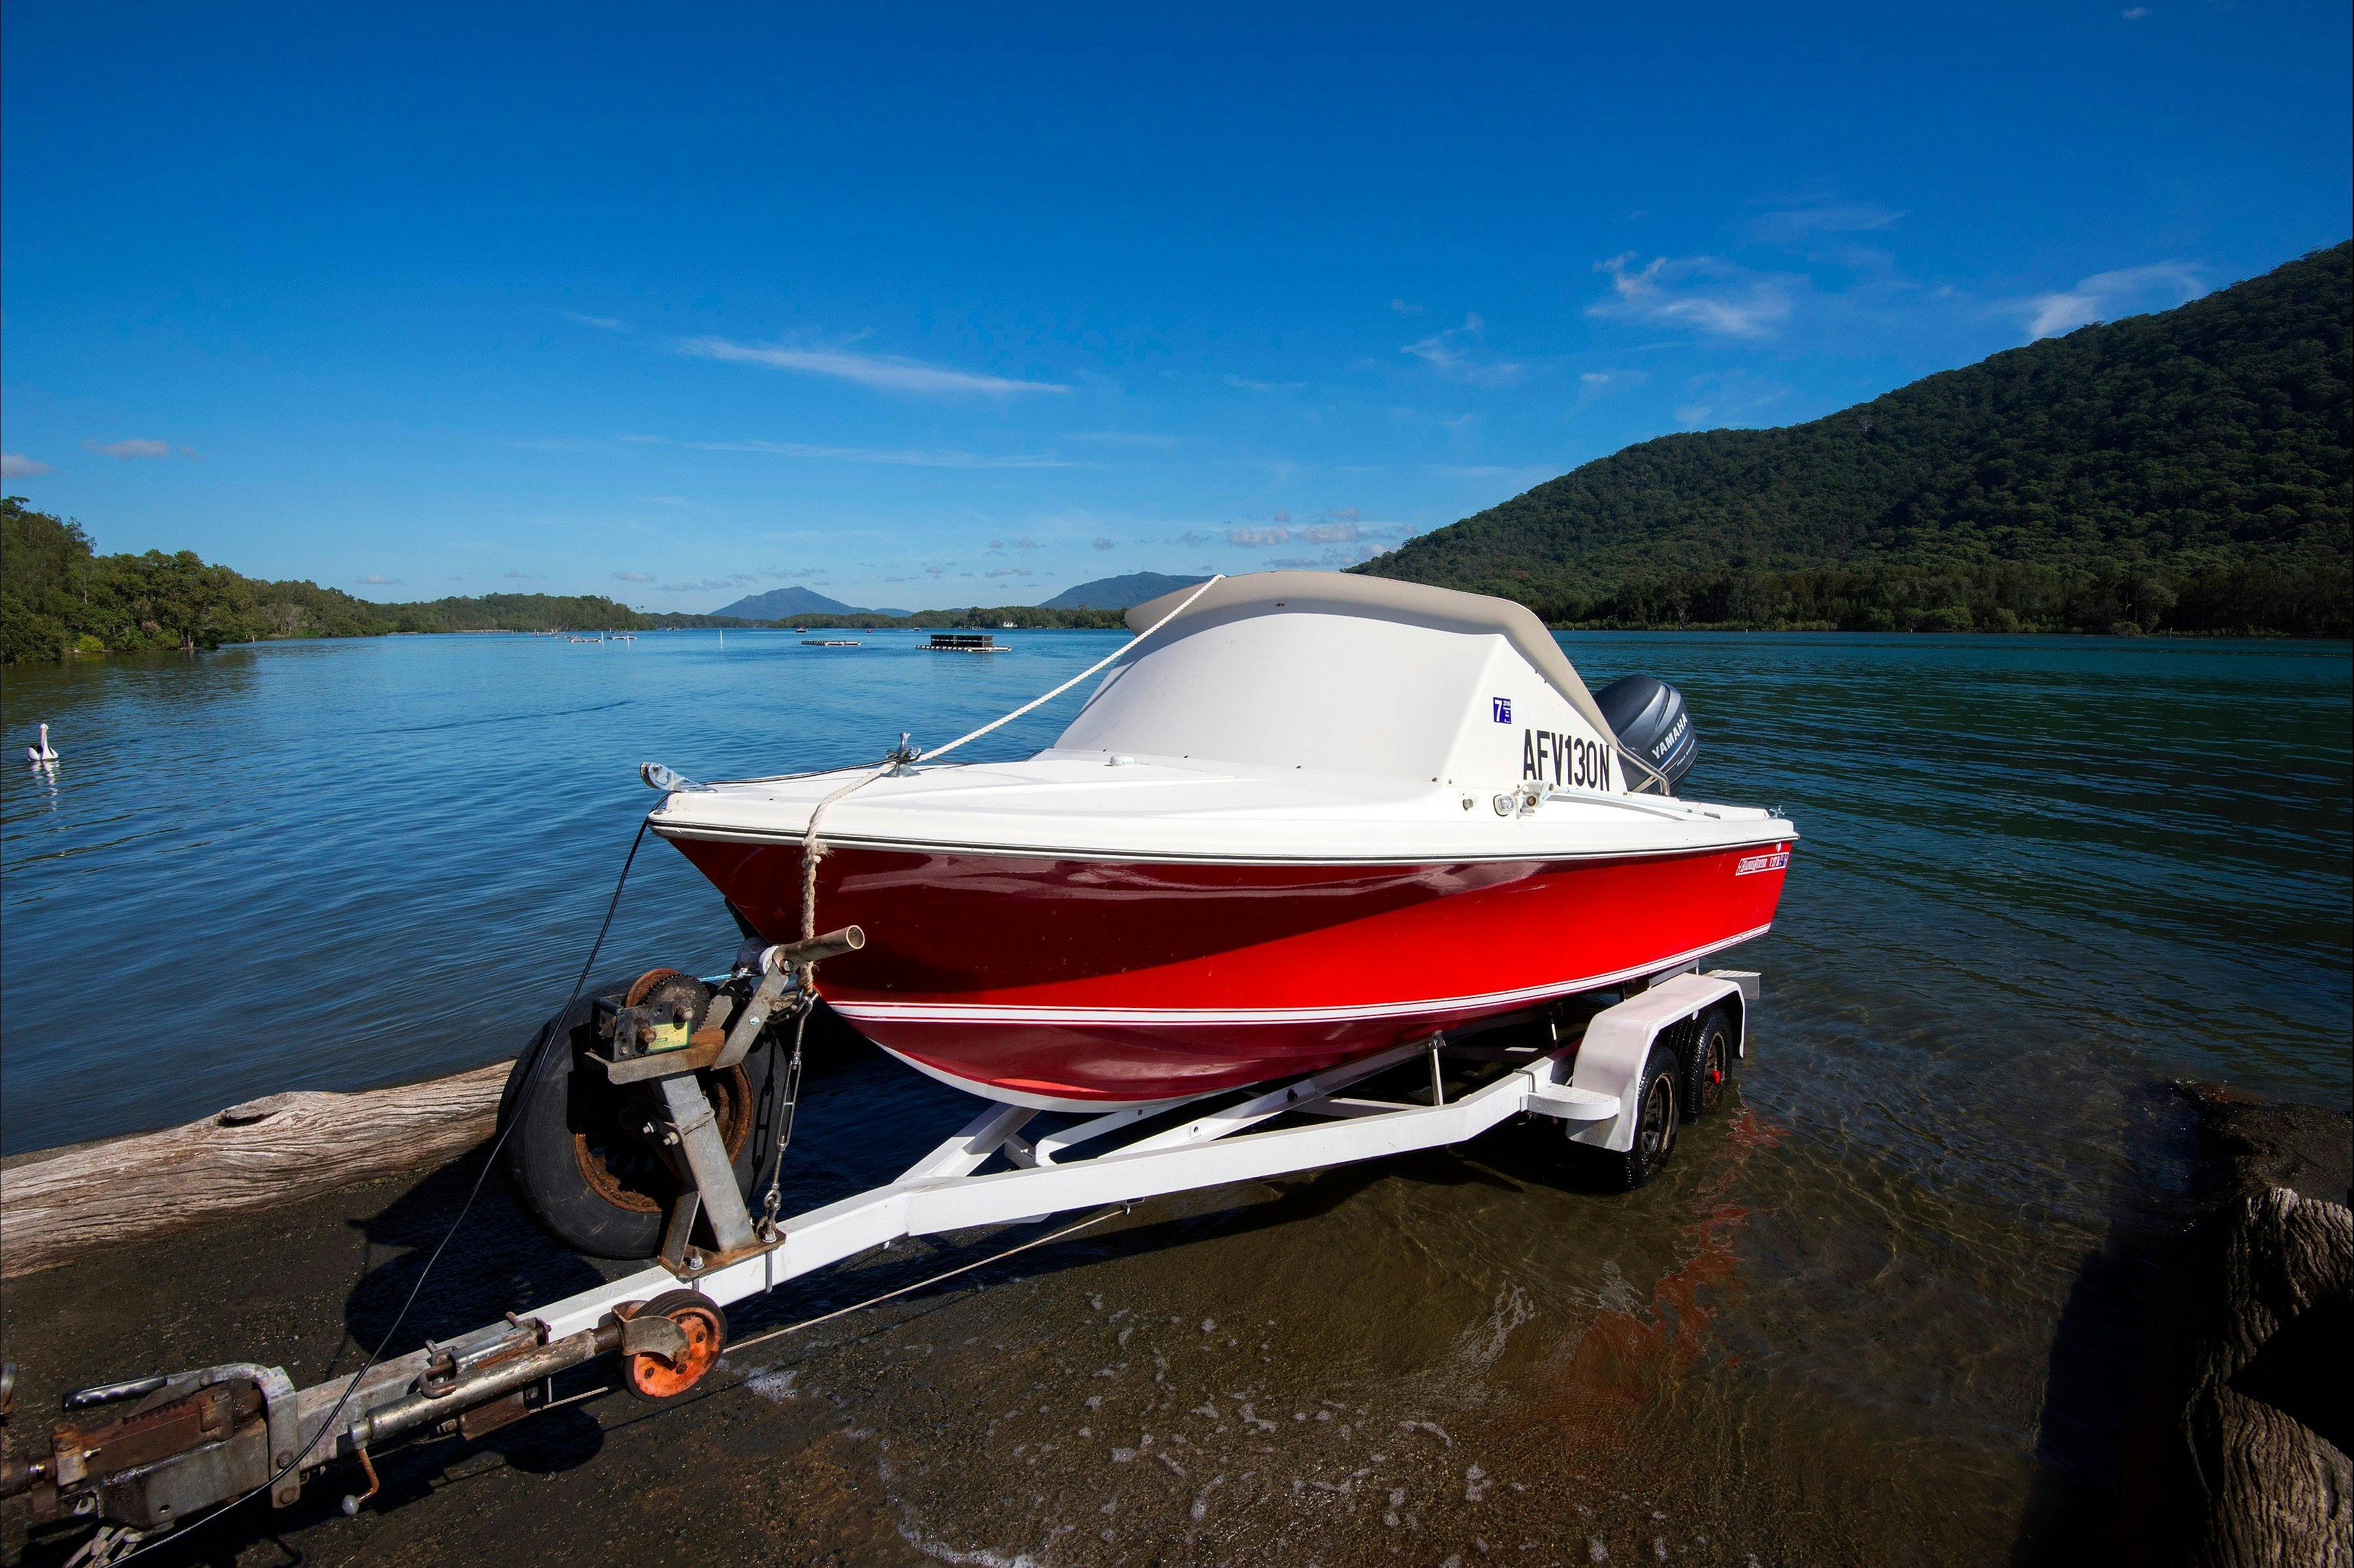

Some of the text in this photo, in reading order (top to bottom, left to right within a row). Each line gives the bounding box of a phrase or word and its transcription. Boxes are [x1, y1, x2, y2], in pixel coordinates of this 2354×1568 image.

[1494, 699, 1503, 722] 7
[1523, 728, 1610, 792] AFV130N
[1651, 712, 1688, 760] YAMAHA
